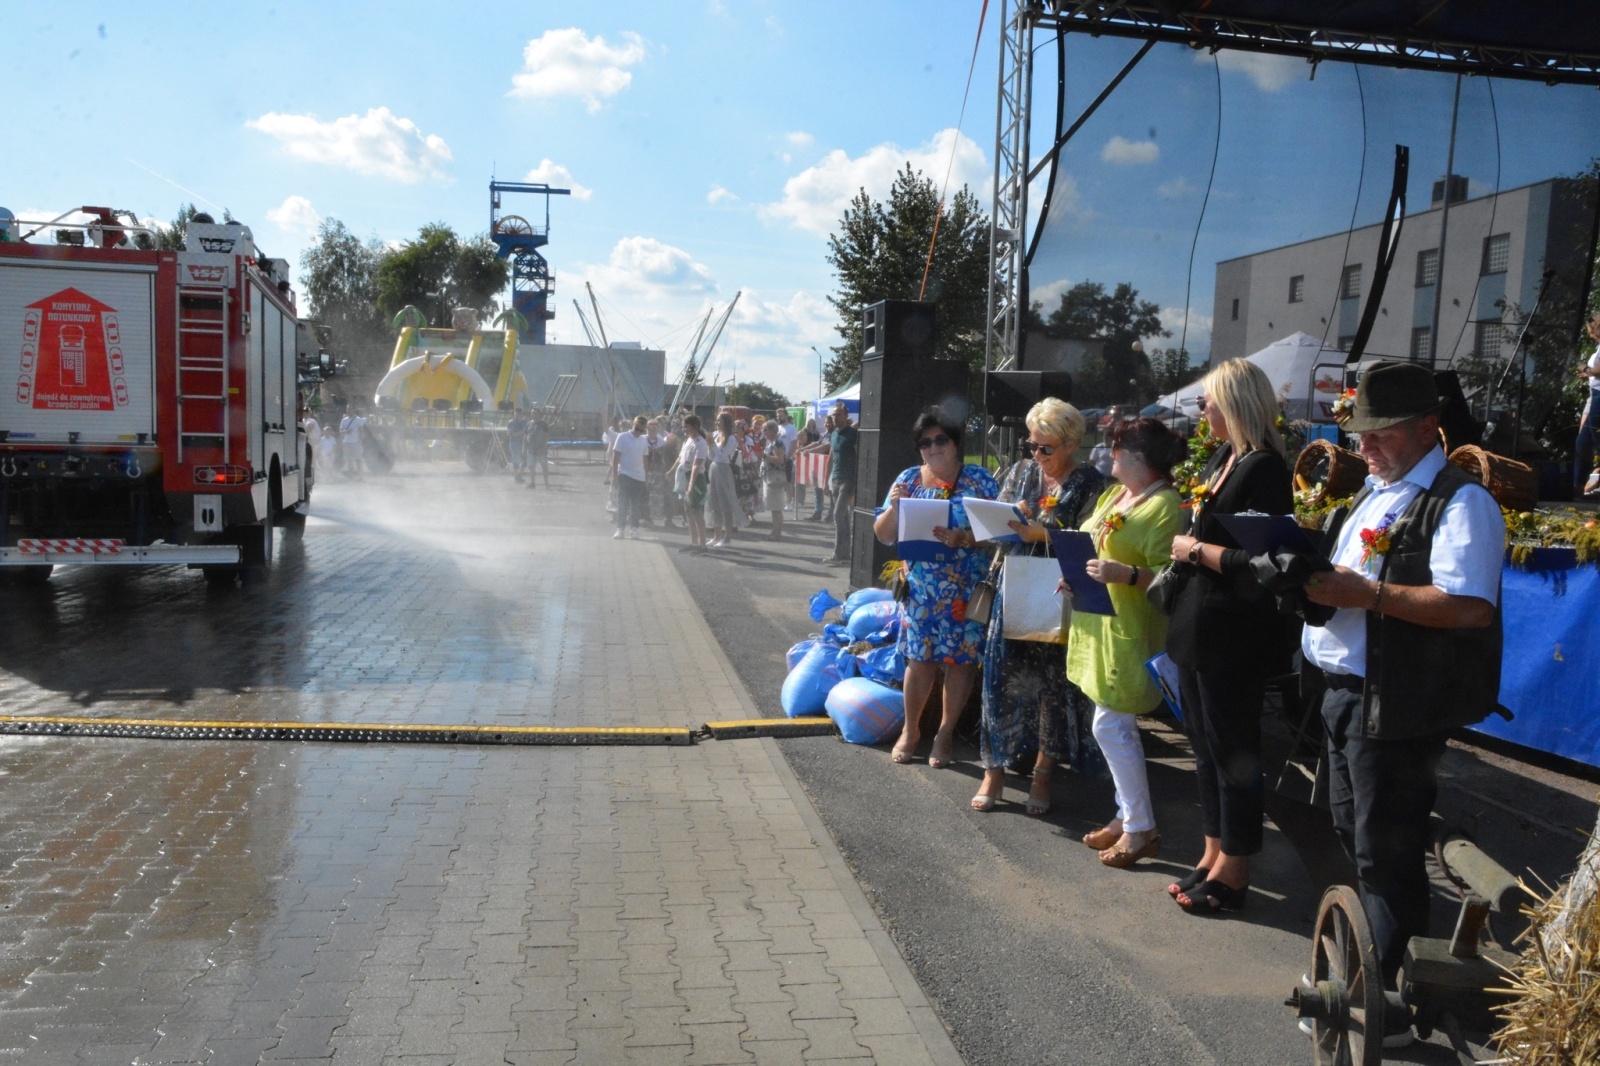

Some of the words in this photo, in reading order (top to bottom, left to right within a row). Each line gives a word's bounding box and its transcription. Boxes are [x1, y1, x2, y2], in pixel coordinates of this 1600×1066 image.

[52, 302, 91, 311] KORYTARZ
[48, 313, 96, 322] RATUNKOWY
[64, 360, 74, 370] 112
